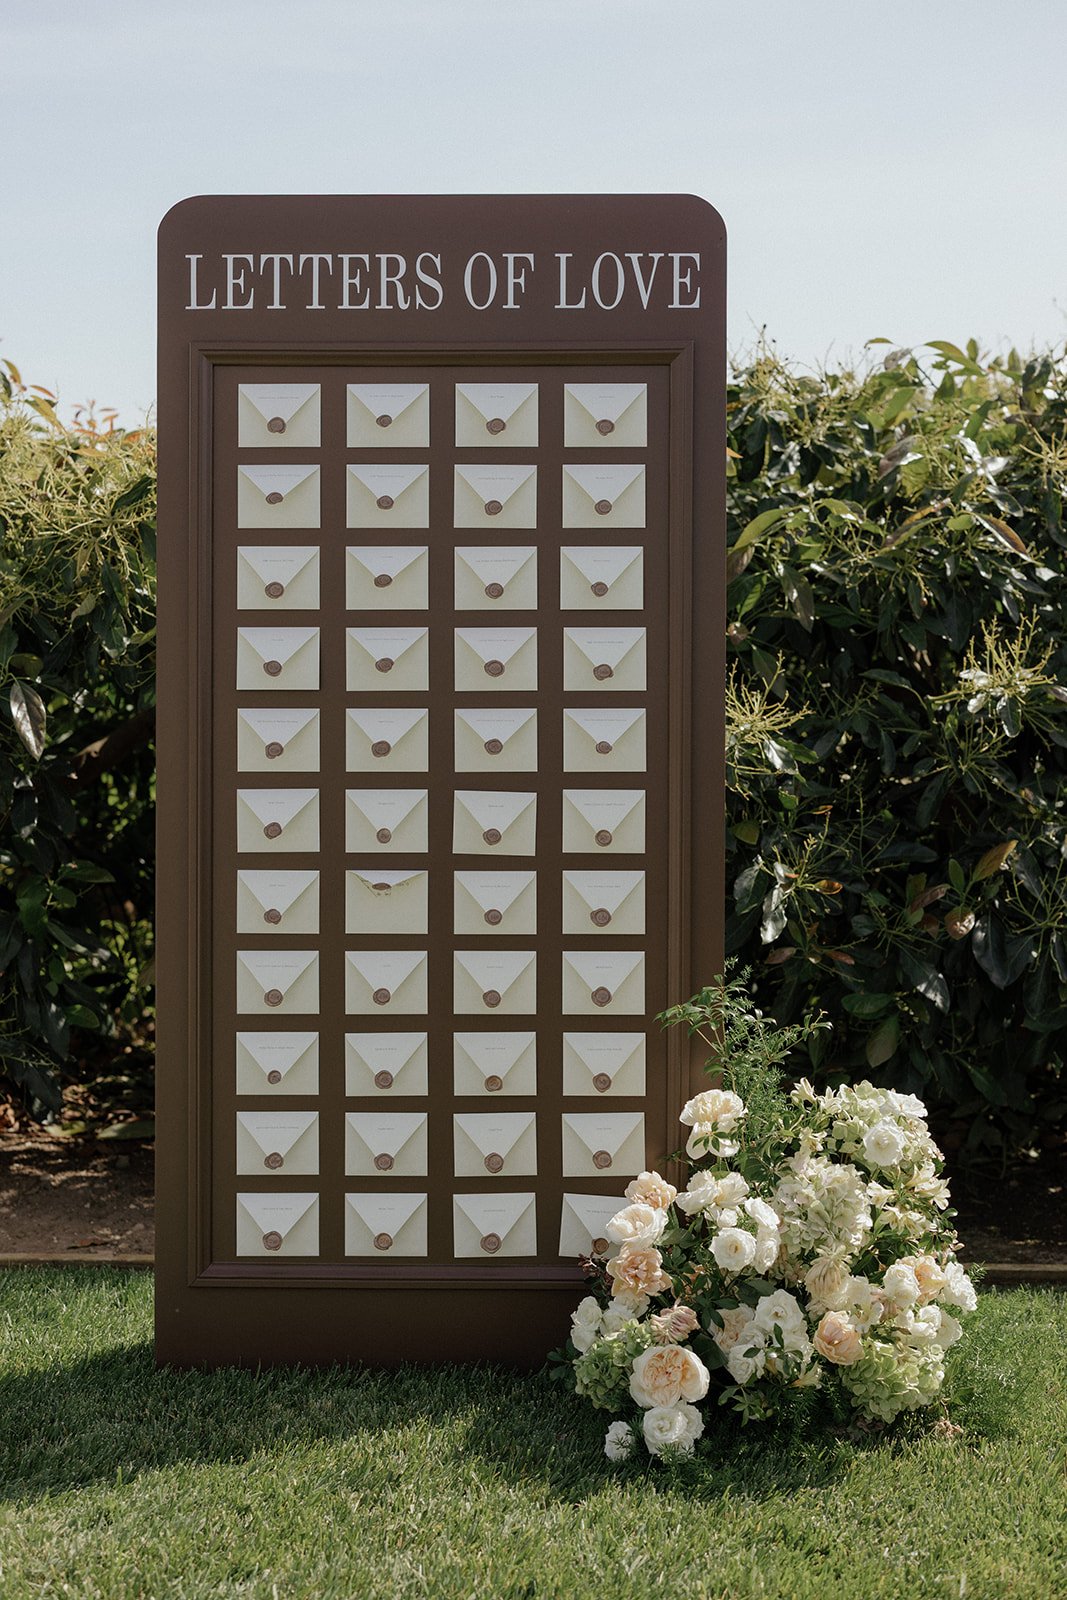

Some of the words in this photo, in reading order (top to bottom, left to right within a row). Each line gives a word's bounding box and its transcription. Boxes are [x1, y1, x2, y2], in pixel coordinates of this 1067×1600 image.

[185, 253, 443, 310] LETTERS
[465, 252, 534, 309] OF
[555, 252, 700, 309] LOVE
